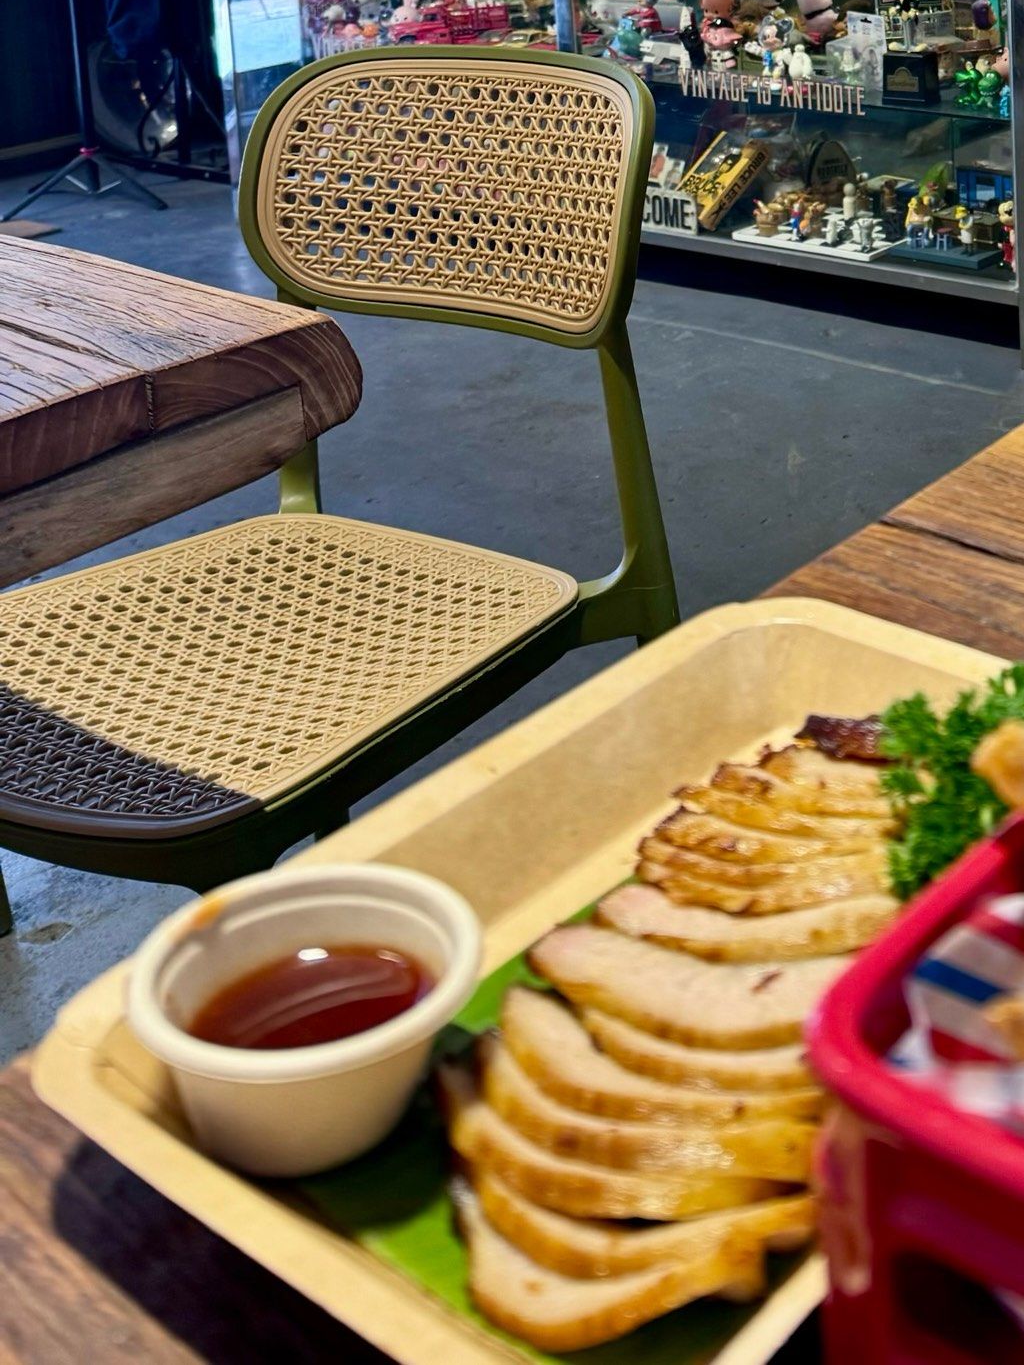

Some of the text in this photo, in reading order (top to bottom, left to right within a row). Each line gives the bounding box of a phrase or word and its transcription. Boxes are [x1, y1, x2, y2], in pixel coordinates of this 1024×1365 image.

[678, 67, 866, 116] VINTAGE IS ANTIDOTE
[724, 150, 766, 207] BRUCE LEE
